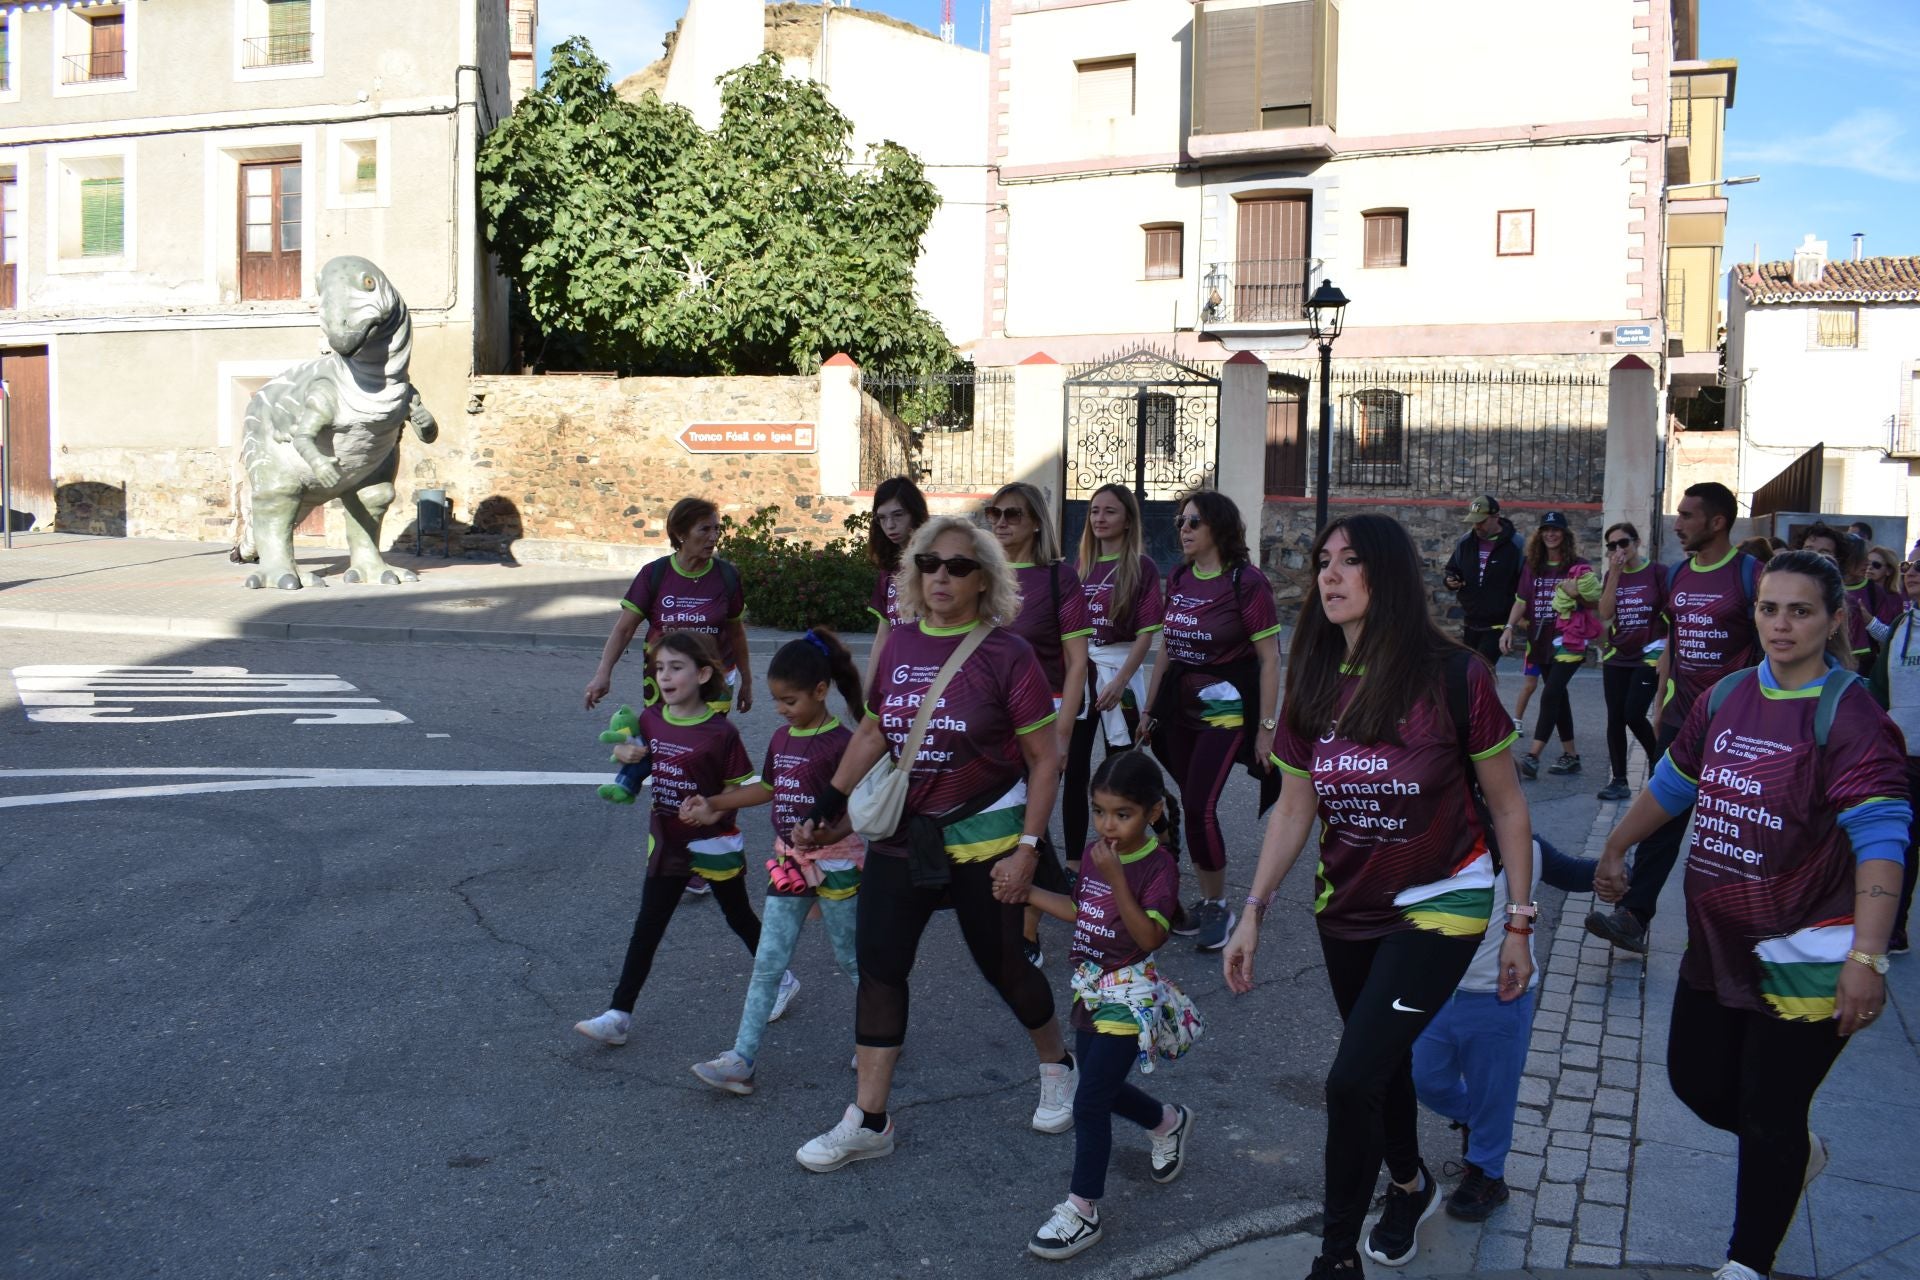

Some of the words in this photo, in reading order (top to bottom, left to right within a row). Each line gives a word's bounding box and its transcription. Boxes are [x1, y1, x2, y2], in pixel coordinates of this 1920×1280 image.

[688, 431, 722, 442] Tronco
[725, 430, 750, 442] Fósil
[753, 431, 766, 442] de
[770, 431, 793, 443] Igea
[1625, 597, 1643, 605] Rioja
[1626, 605, 1653, 613] marcha
[661, 613, 675, 622] La
[677, 613, 706, 624] Rioja
[1165, 611, 1173, 621] La
[1175, 613, 1198, 626] Rioja
[1675, 613, 1686, 623] La
[1688, 613, 1713, 626] Rioja
[1173, 630, 1213, 641] marcha
[1677, 626, 1687, 637] En
[1688, 628, 1728, 639] marcha
[1679, 639, 1706, 649] contra
[1175, 647, 1207, 660] cáncer
[1678, 648, 1686, 657] el
[1687, 649, 1722, 660] cáncer
[885, 694, 903, 707] La
[882, 713, 903, 728] En
[1731, 741, 1751, 751] contra
[1763, 740, 1793, 753] española
[913, 750, 954, 762] áncer
[1735, 749, 1743, 757] La
[659, 762, 683, 776] Rioja
[1314, 756, 1332, 772] La
[1338, 754, 1388, 774] Rioja
[659, 778, 698, 790] marcha
[1700, 764, 1715, 783] La
[1717, 768, 1762, 796] Rioja
[652, 786, 678, 797] ontra
[1314, 780, 1338, 796] En
[1341, 778, 1420, 795] marcha
[1324, 796, 1381, 812] contra
[1698, 789, 1711, 809] En
[1715, 798, 1784, 831] marcha
[1329, 811, 1347, 825] el
[1349, 811, 1408, 831] cáncer
[1695, 812, 1739, 839] contra
[1691, 830, 1700, 847] el
[1703, 835, 1763, 866] cáncer
[1081, 901, 1104, 919] Rioja
[1079, 919, 1116, 938] marcha
